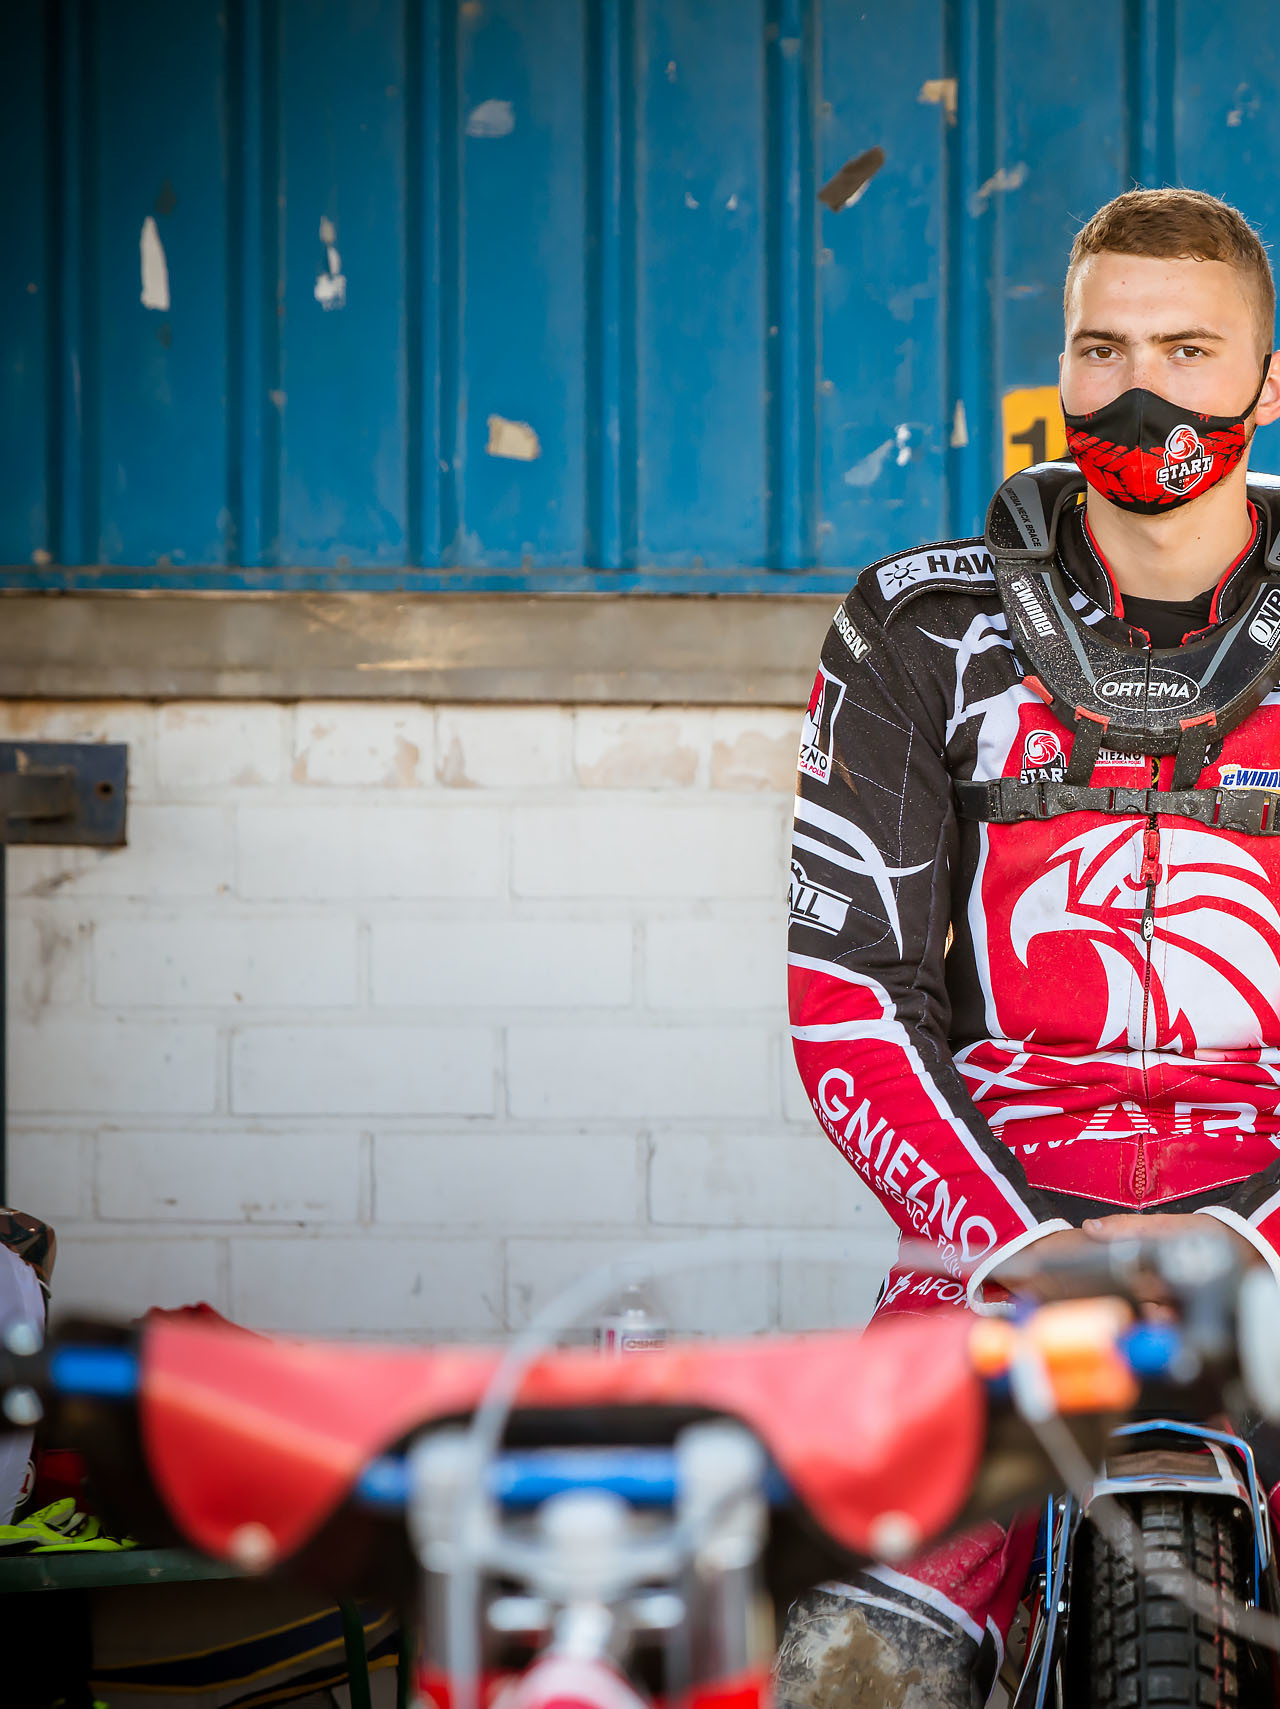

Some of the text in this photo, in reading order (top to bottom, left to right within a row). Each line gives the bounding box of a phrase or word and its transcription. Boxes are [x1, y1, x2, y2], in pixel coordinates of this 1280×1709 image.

[1158, 456, 1212, 482] START
[1016, 506, 1031, 523] NECK
[1025, 524, 1042, 547] BRACE
[1102, 681, 1190, 699] ORTEMA
[1020, 768, 1068, 784] STAR
[812, 1097, 871, 1181] PIERWSZA
[875, 1175, 933, 1240] STOLICA
[817, 1067, 998, 1263] GNIEZNO
